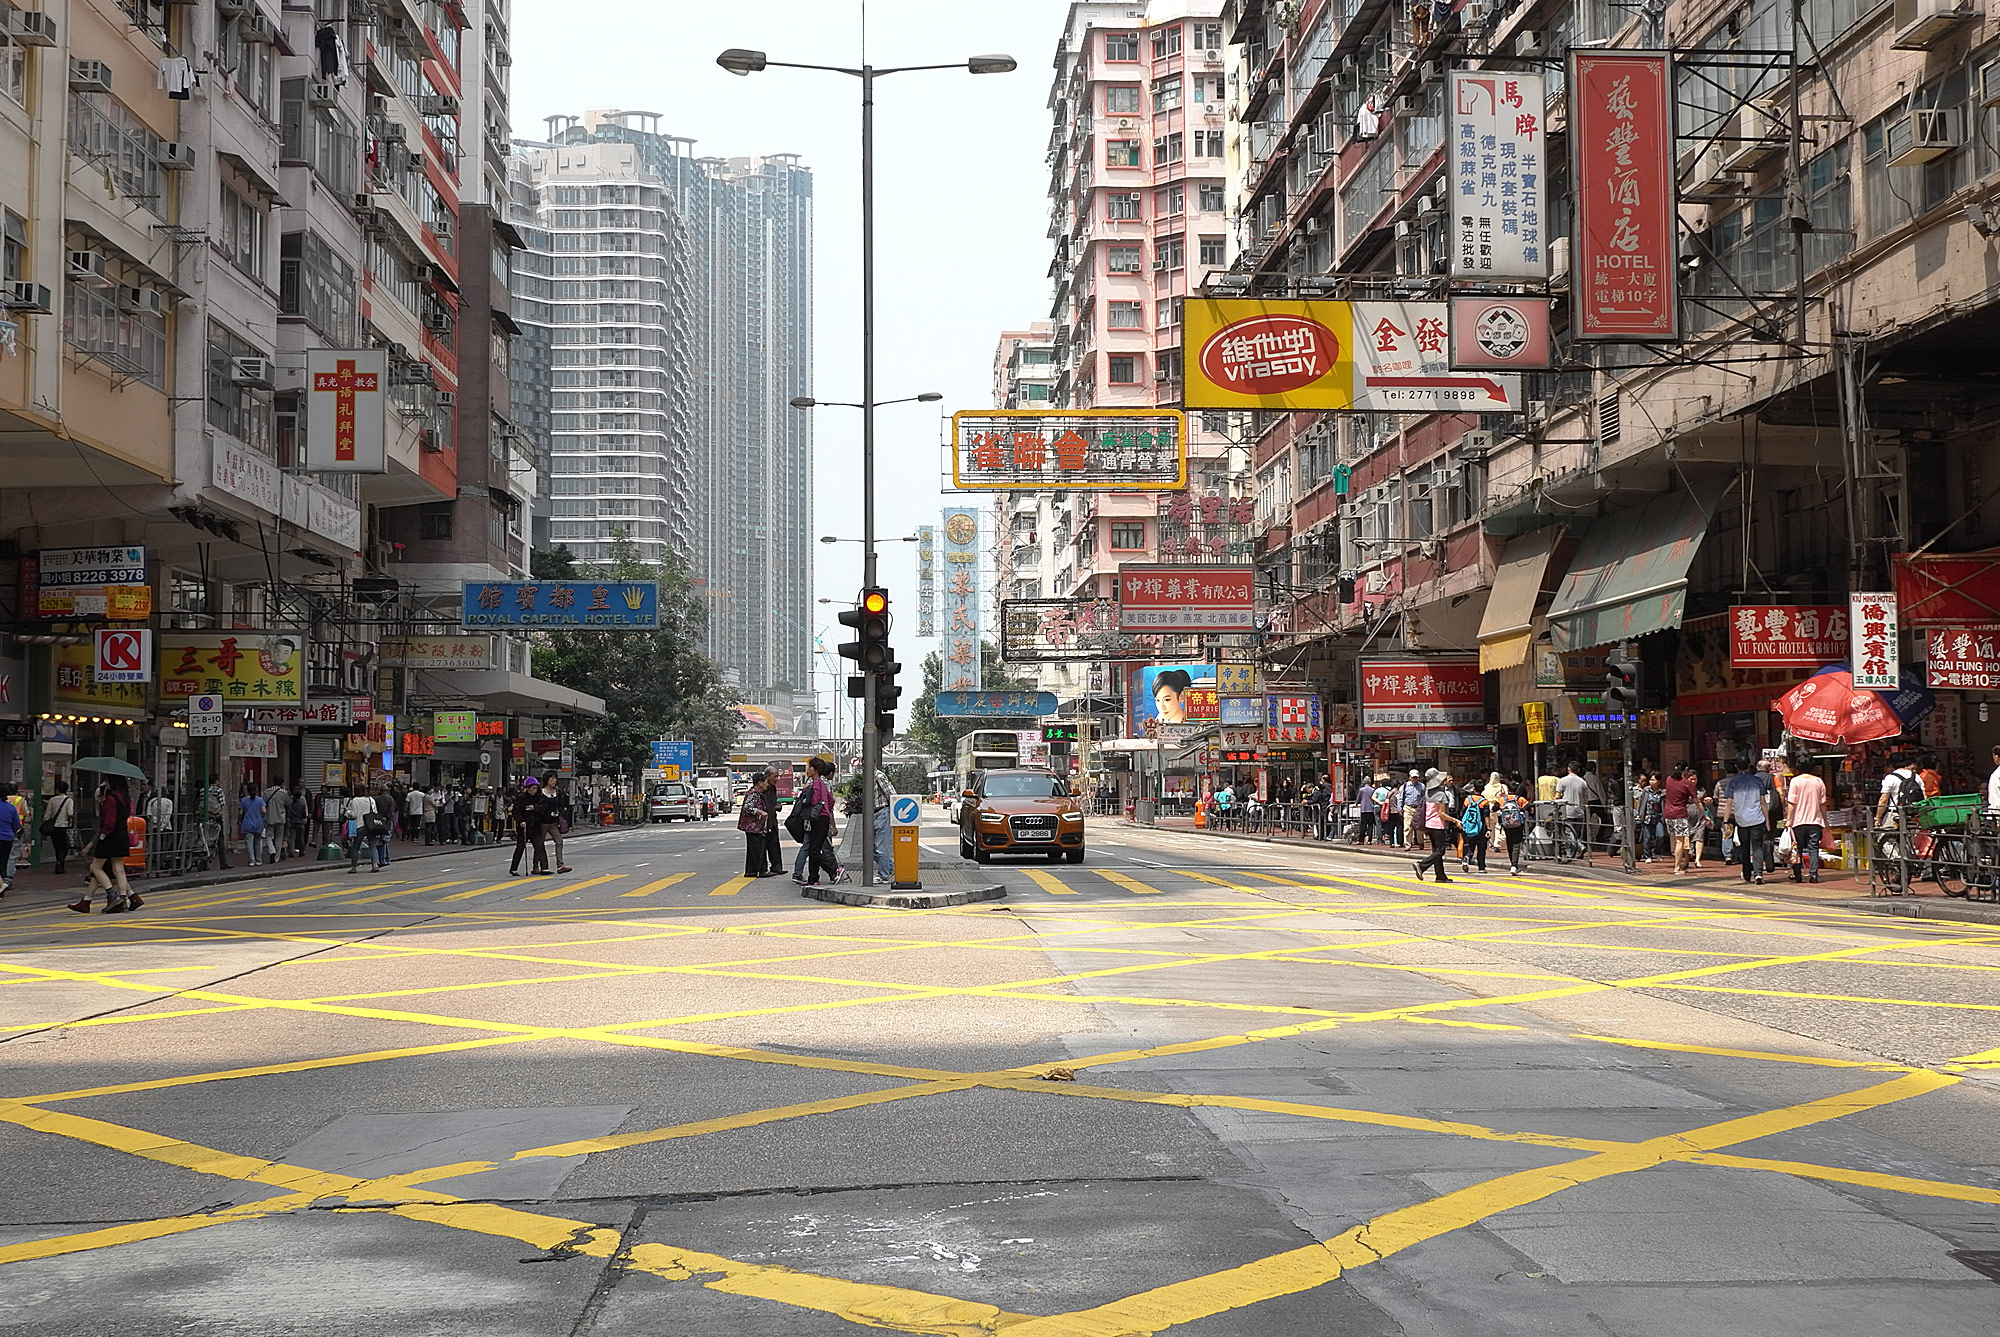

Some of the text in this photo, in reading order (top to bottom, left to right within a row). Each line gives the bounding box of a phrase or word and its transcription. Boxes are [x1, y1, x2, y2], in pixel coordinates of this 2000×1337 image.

[1500, 81, 1539, 142] 馬牌
[1480, 134, 1497, 208] 德克牌九
[1605, 75, 1640, 253] 藝豐酒店
[1500, 142, 1519, 235] 現成套裝碼
[1521, 154, 1539, 264] 半寶石地球儀
[1479, 217, 1492, 270] 無任歡迎
[1596, 255, 1654, 270] HOTEL
[1595, 272, 1657, 287] 統一大廈
[1595, 289, 1658, 304] 電梯10字
[1220, 327, 1317, 365] 維他奶
[1372, 317, 1448, 353] 金發
[317, 376, 376, 388] 真光 教会
[1382, 390, 1476, 399] Tel: 2771 9898
[339, 368, 353, 451] 华语礼拜堂
[971, 430, 1090, 471] 雀聯會
[1168, 494, 1253, 526] 荷里活
[71, 549, 124, 565] 美華物業
[41, 569, 144, 584] 周小姐 8226 3978
[1126, 577, 1249, 601] 中輝藥業有限公司
[1877, 595, 1896, 603] HOTEL
[467, 613, 516, 625] ROYAL
[519, 613, 580, 625] CAPITAL
[584, 613, 630, 624] HOTEL
[1734, 609, 1848, 641] 藝豐酒店
[1737, 642, 1751, 655] YU
[1753, 642, 1777, 655] FONG
[1780, 642, 1807, 655] HOTEL
[1861, 603, 1889, 676] 僑興賓館
[172, 637, 244, 678] 三哥
[1930, 660, 2000, 671] NGAI FUNG HO
[98, 672, 144, 681] 24小時營業
[166, 681, 199, 693] 譚仔
[1366, 674, 1480, 697] 中輝藥業有限公司
[202, 726, 218, 735] 5-7
[1225, 731, 1264, 746] 荷里活
